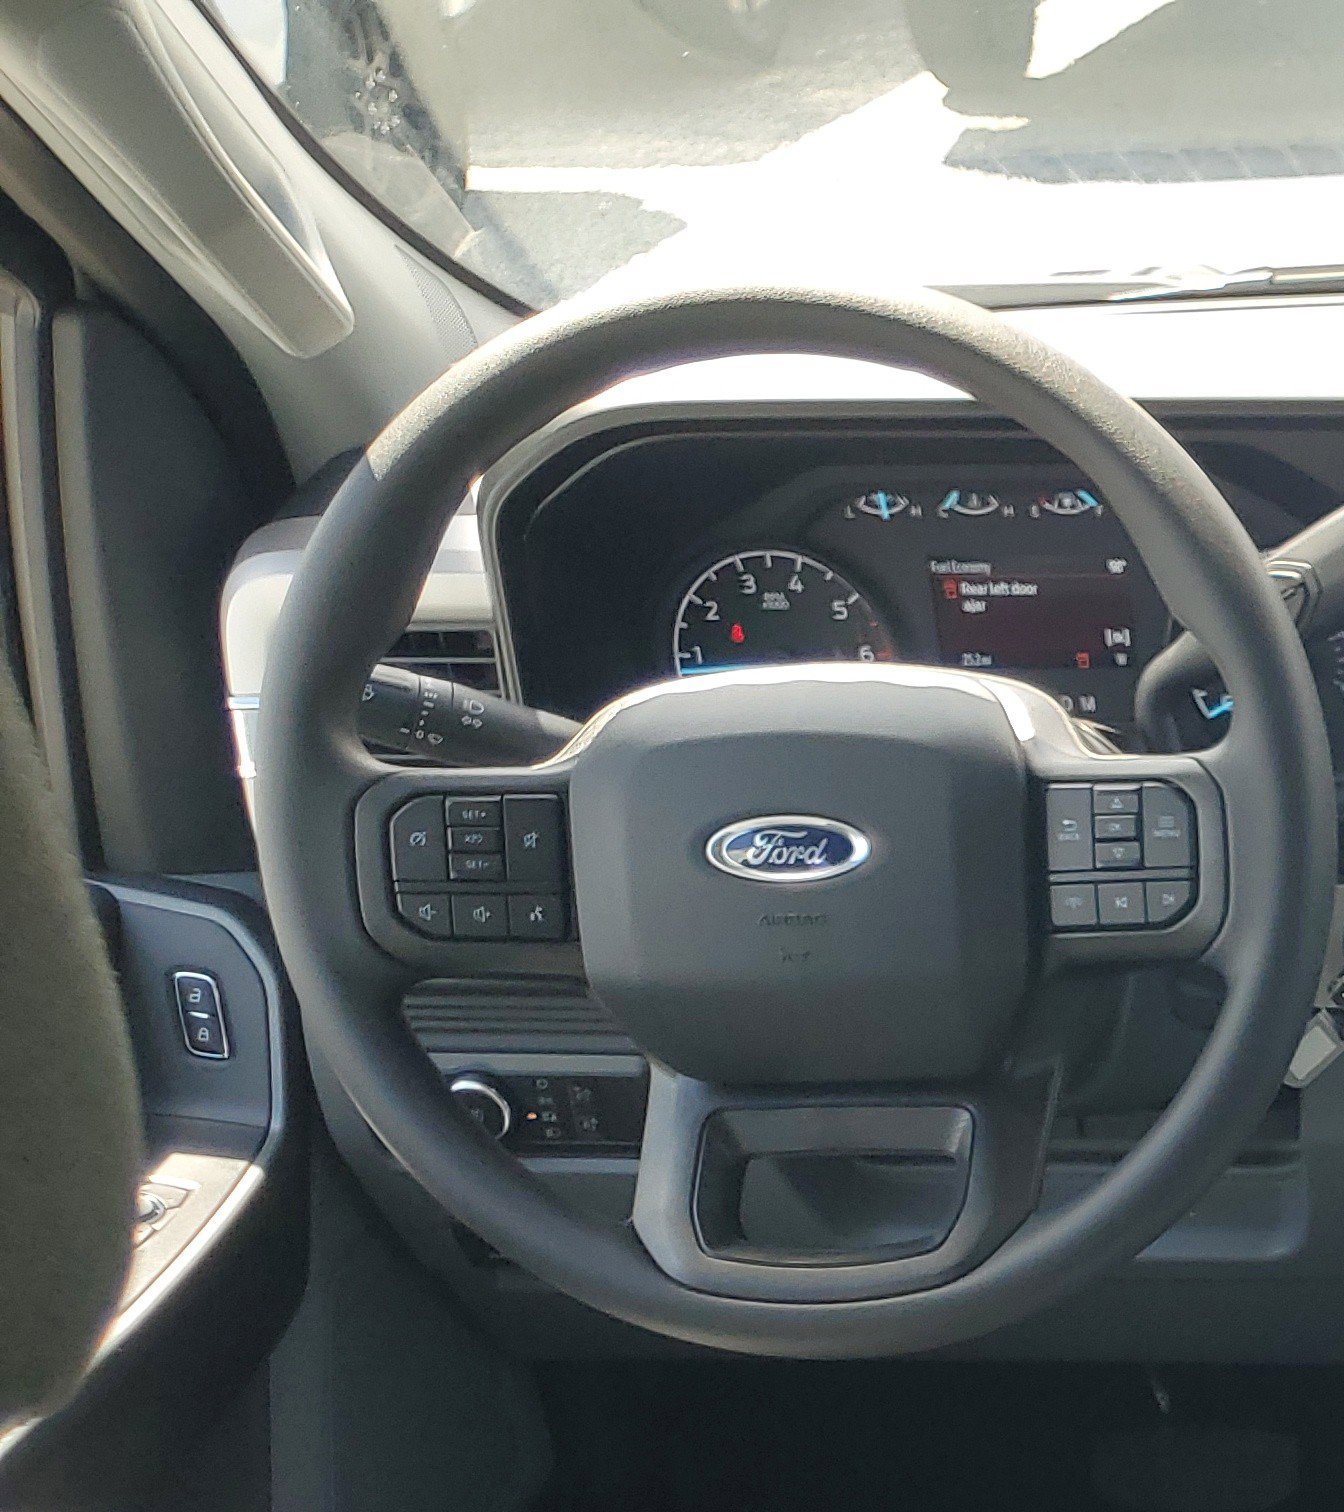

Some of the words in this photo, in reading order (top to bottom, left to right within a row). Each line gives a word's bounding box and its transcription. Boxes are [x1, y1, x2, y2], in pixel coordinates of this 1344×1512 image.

[738, 573, 758, 595] 3
[787, 574, 805, 594] 4
[960, 580, 988, 597] Rear
[1011, 579, 1039, 596] door
[703, 601, 721, 621] 2
[831, 601, 849, 620] 5
[858, 644, 875, 662] 6
[744, 829, 829, 866] Ford
